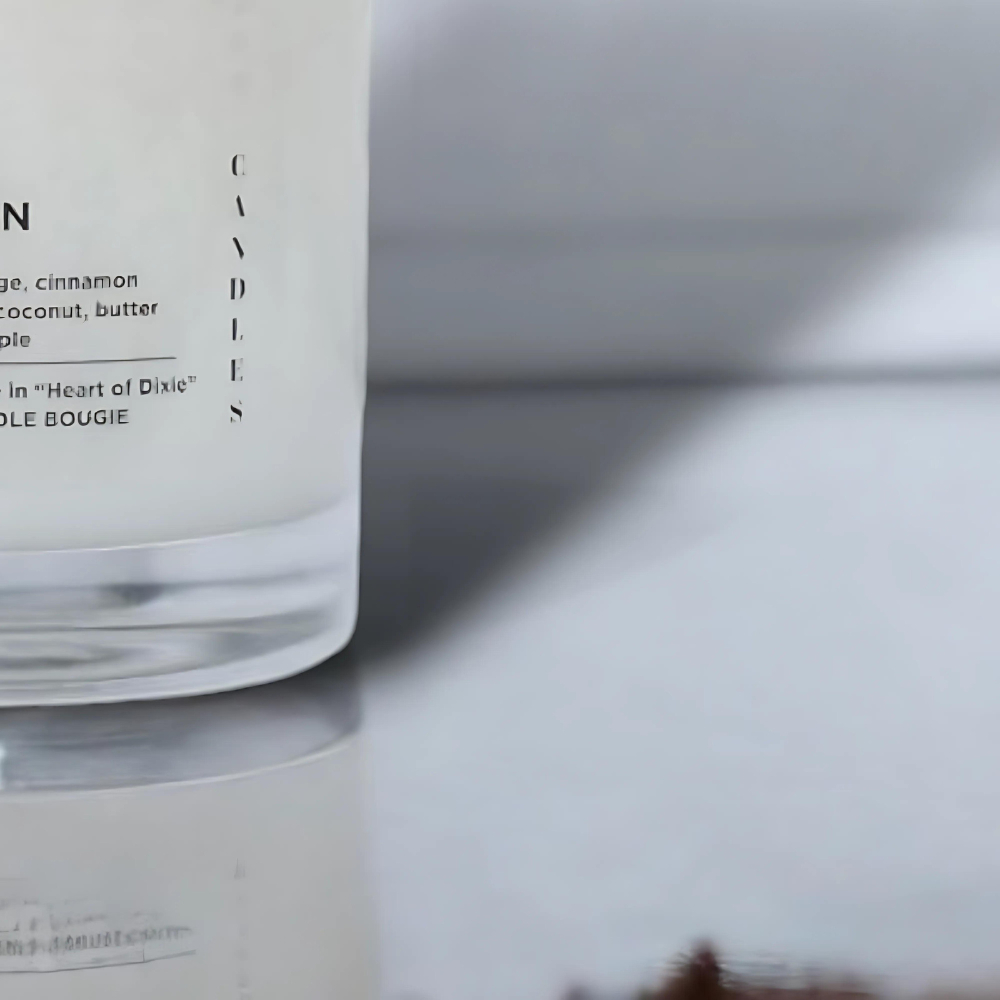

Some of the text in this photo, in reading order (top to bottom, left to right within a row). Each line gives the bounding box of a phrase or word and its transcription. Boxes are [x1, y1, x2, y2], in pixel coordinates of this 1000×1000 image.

[35, 273, 138, 291] cinnamon
[230, 153, 247, 424] CANDLES
[95, 299, 159, 318] butter
[8, 380, 28, 399] in
[111, 378, 133, 397] of
[44, 408, 130, 429] BOUGIE
